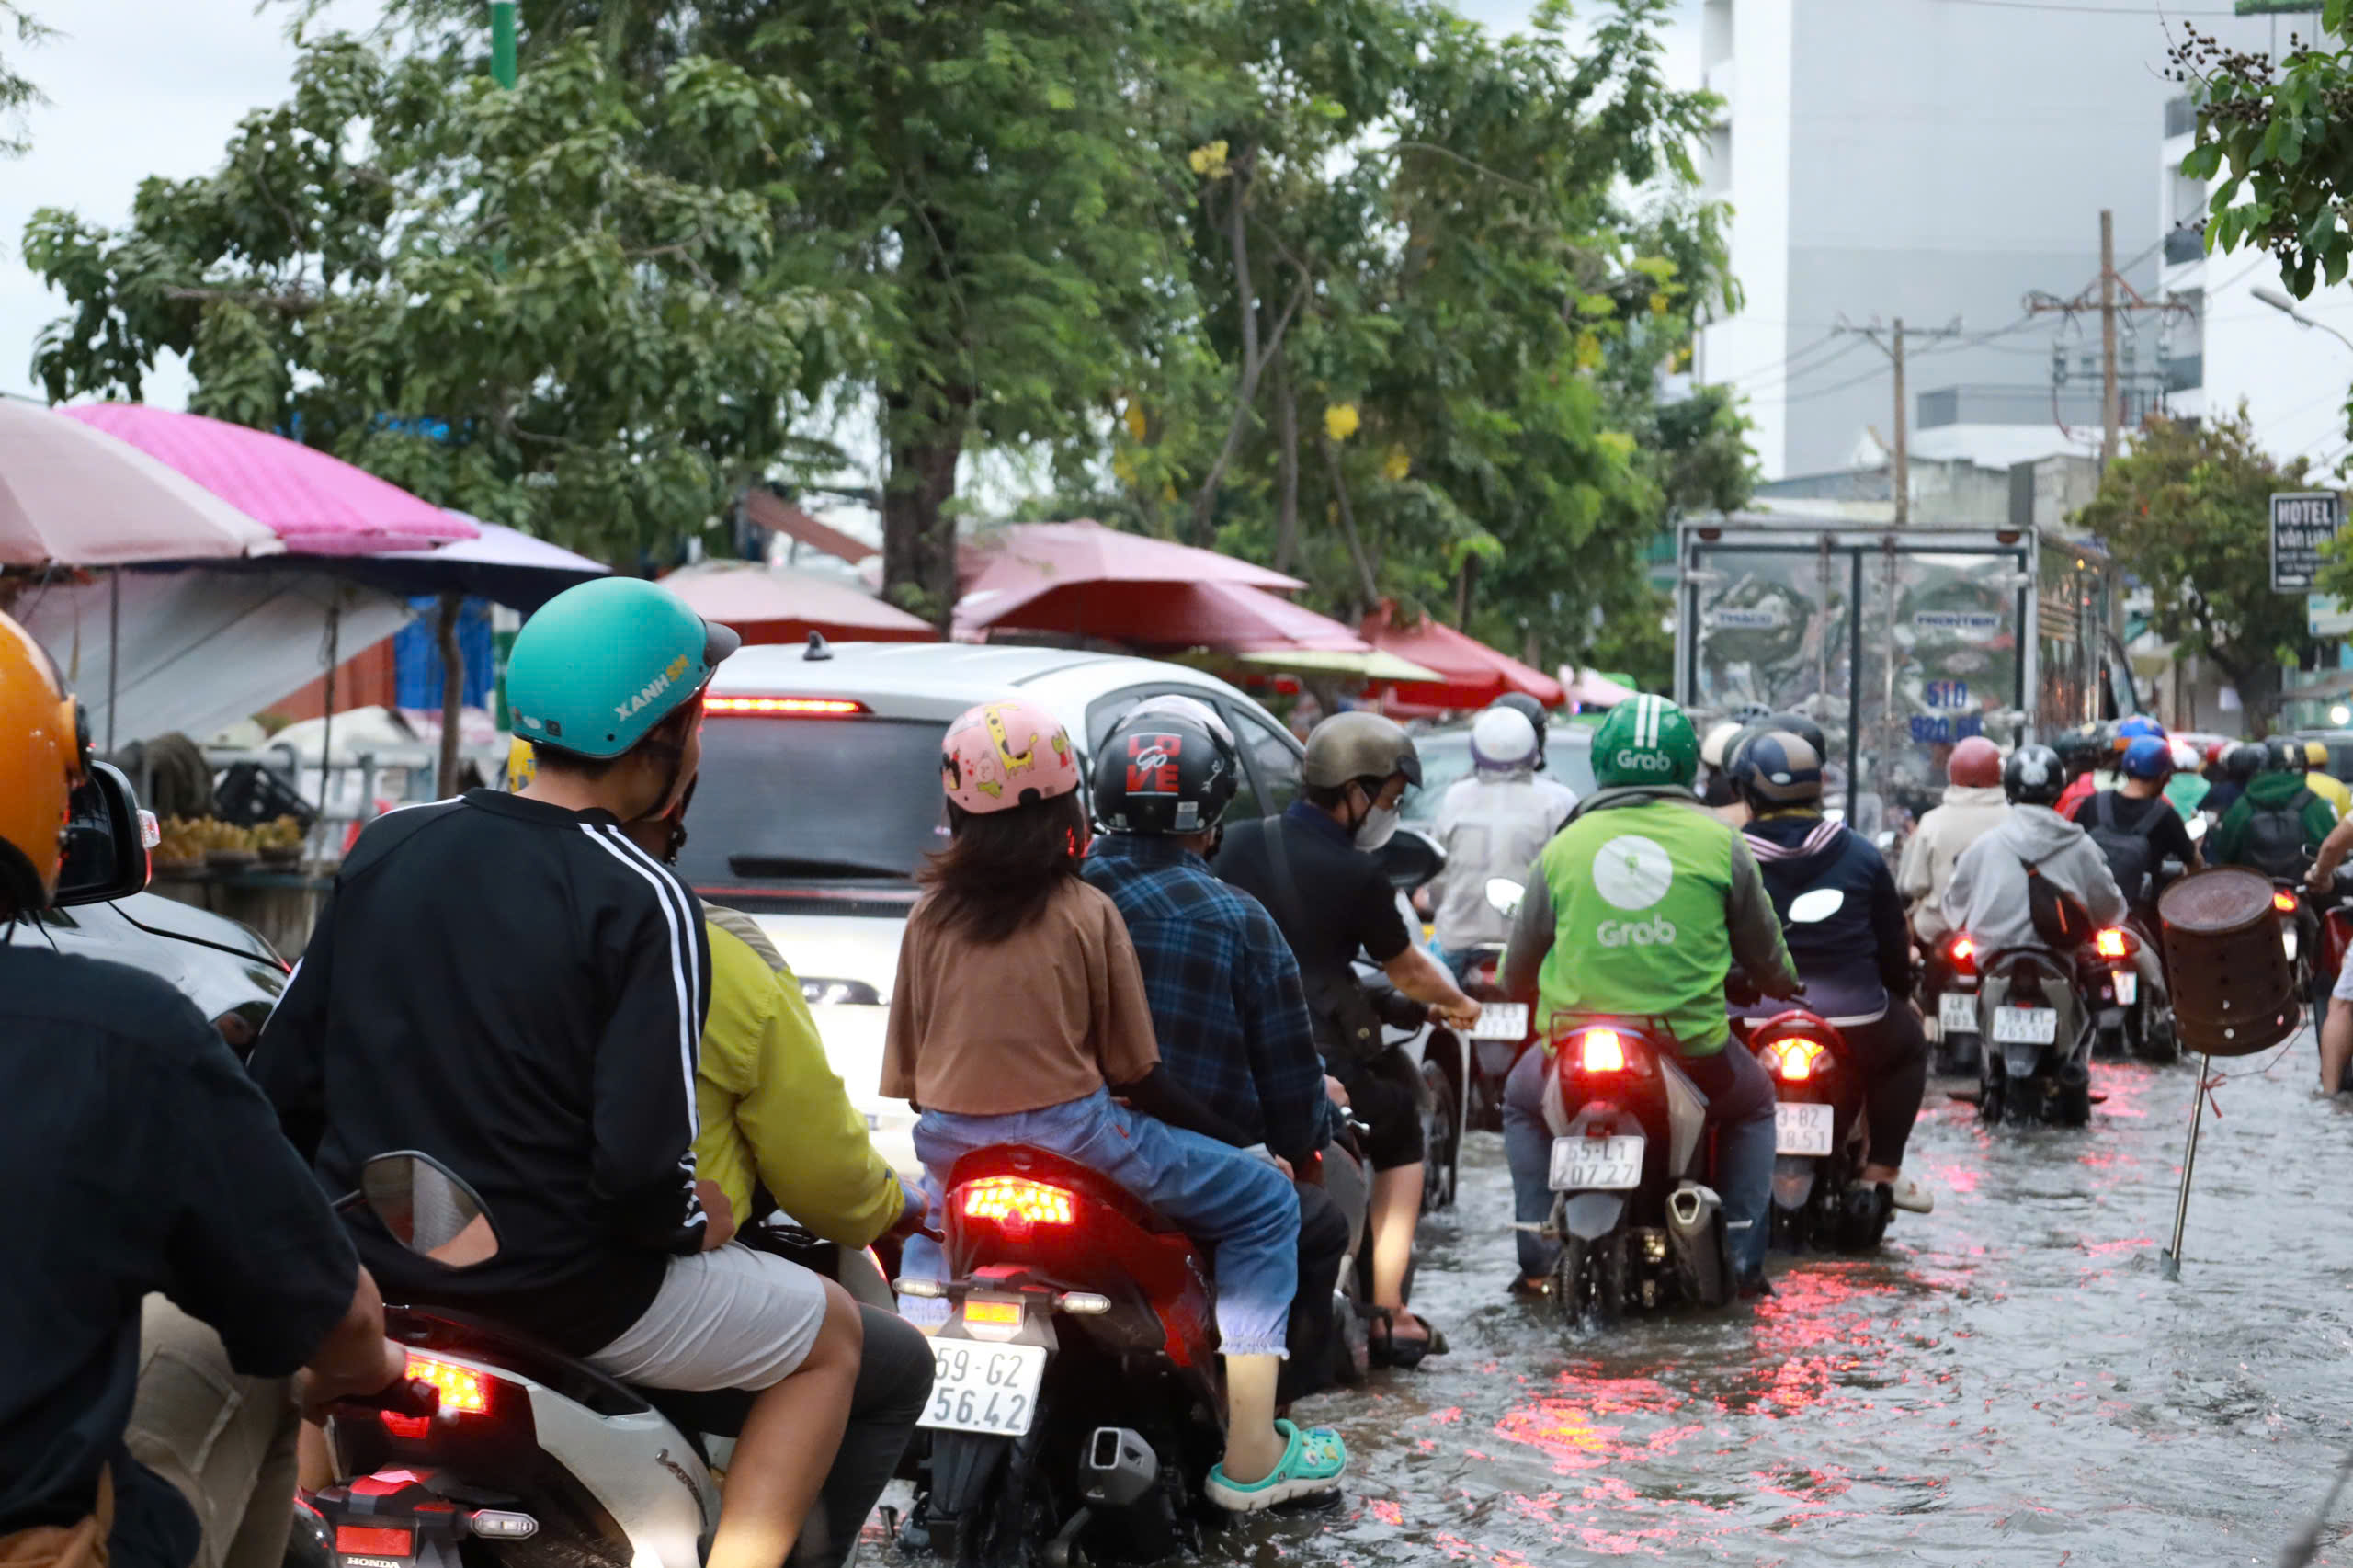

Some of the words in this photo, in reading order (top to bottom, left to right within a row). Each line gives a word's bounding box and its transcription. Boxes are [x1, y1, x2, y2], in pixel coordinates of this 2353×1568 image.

[2278, 501, 2332, 525] HOTEL
[613, 673, 670, 722] XANH
[1617, 749, 1671, 771] Grab
[1597, 914, 1677, 948] Grab
[1778, 1107, 1819, 1128] 3-B2
[936, 1347, 1023, 1388] 59-G2
[347, 1556, 401, 1568] HONDA
